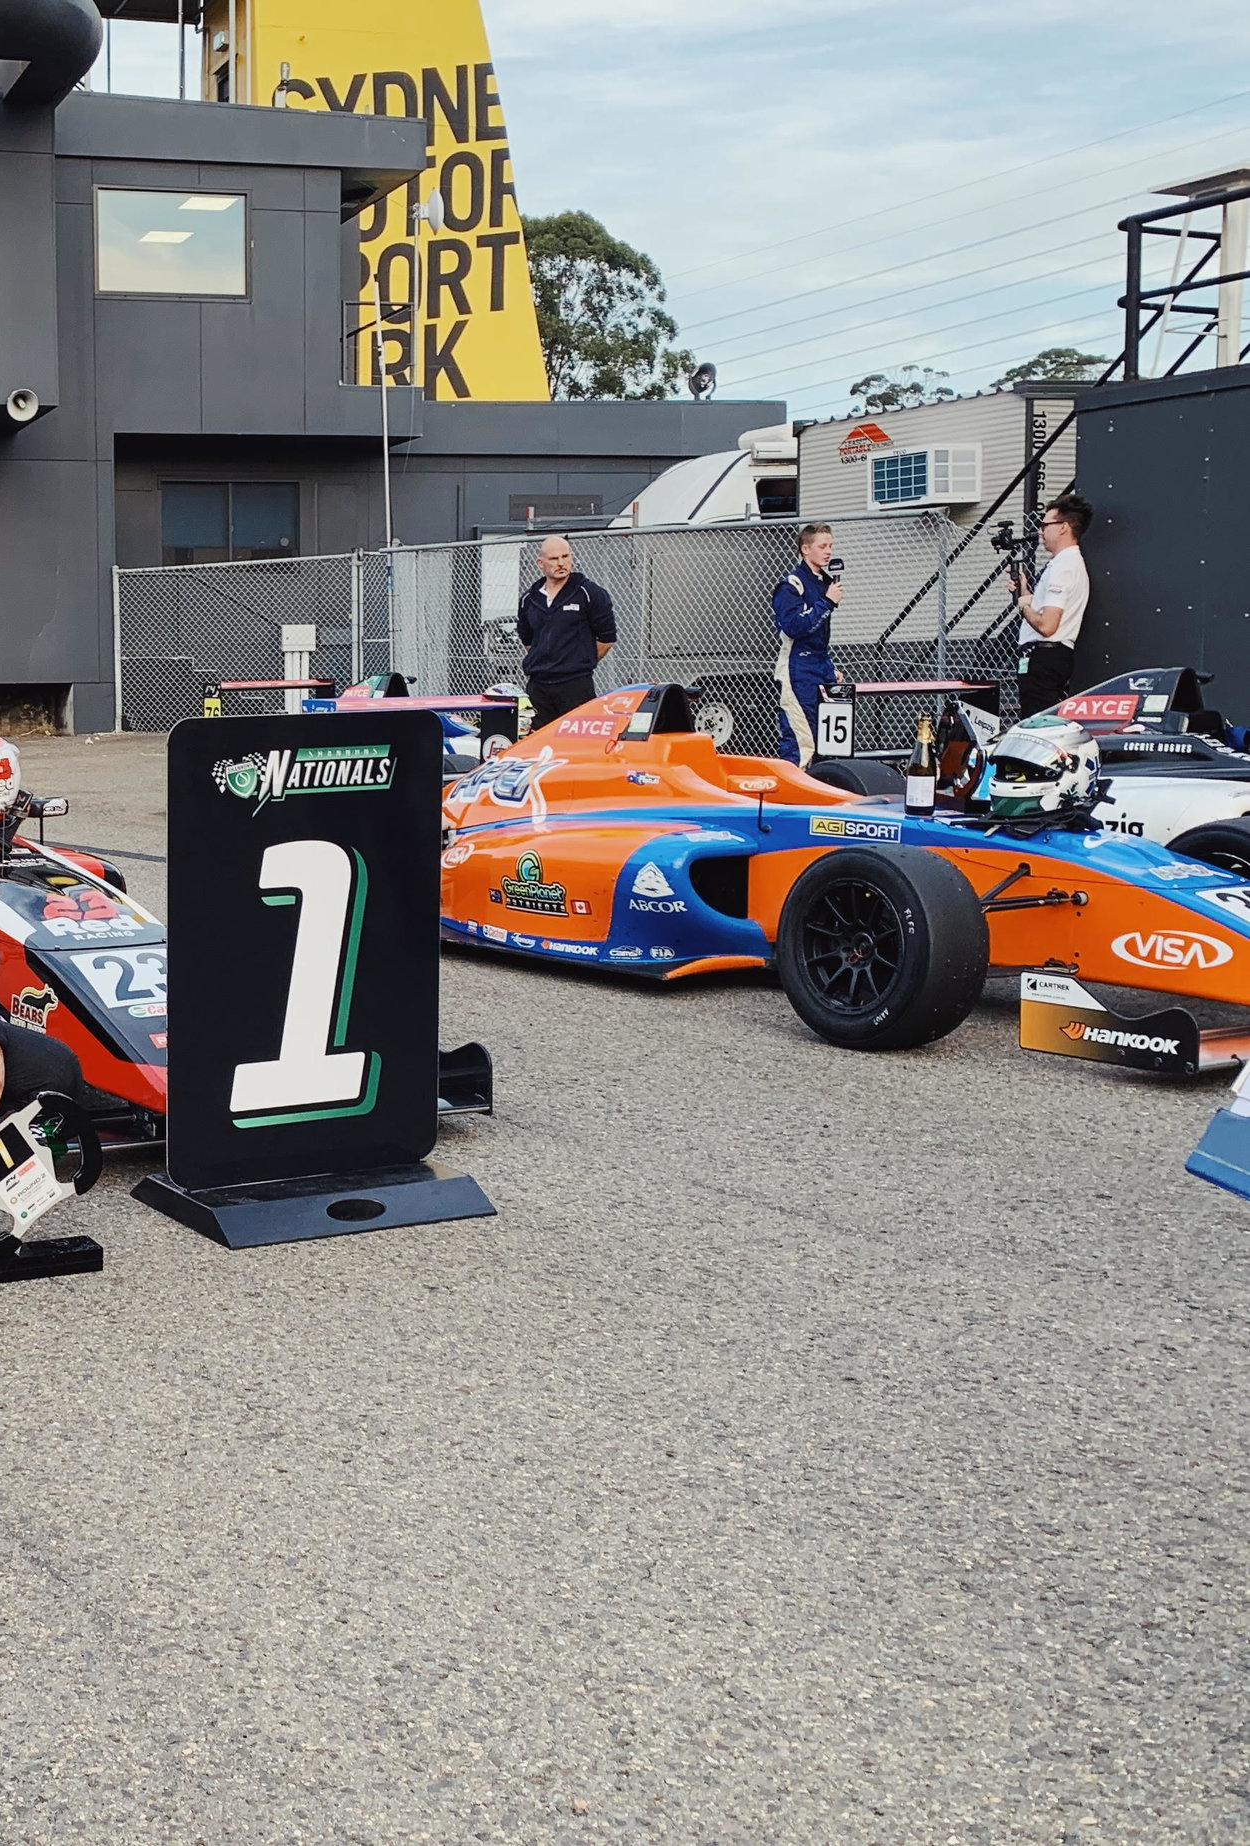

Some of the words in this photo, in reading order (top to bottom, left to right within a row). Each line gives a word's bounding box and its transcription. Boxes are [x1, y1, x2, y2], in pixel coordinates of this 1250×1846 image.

[359, 231, 520, 324] ORT
[1033, 411, 1047, 450] 1300
[1062, 700, 1132, 715] PAYCE
[558, 720, 615, 735] PAYCE
[821, 715, 848, 744] 15
[258, 750, 391, 801] NATIONALS
[815, 821, 844, 835] AGI
[845, 822, 898, 839] SPORT
[629, 899, 688, 913] ABCOR
[42, 913, 144, 937] Red
[72, 929, 136, 941] RACING
[1132, 932, 1207, 969] VISA
[93, 952, 167, 1002] 23
[229, 840, 366, 1112] 1
[1039, 981, 1070, 991] CARTREK
[11, 996, 44, 1025] BEARS
[17, 1176, 41, 1198] ROUND
